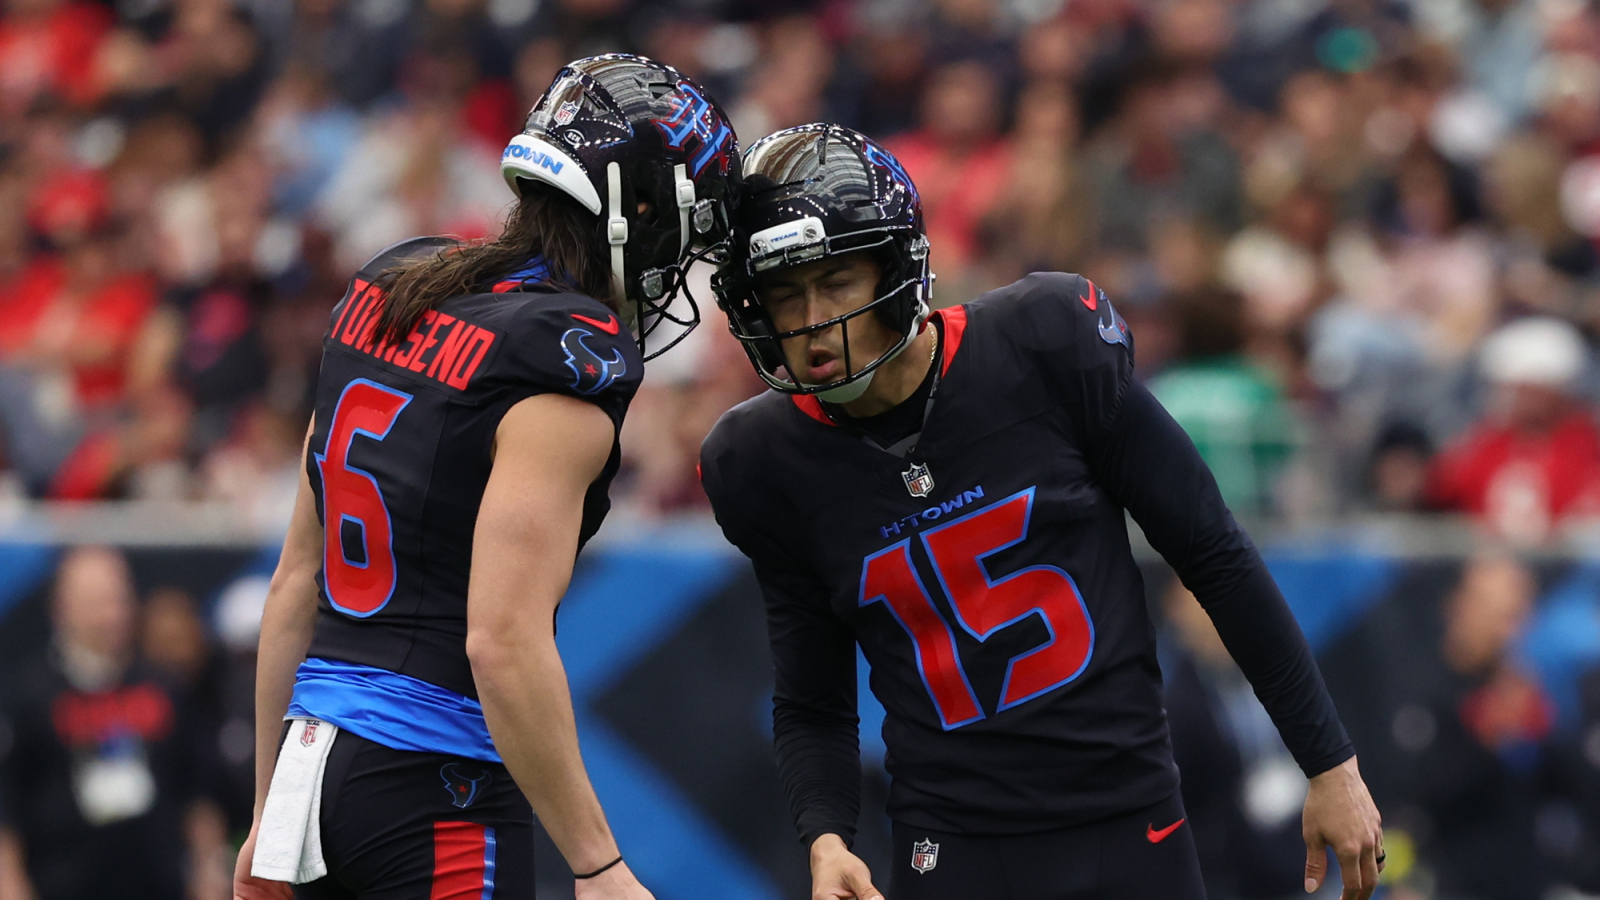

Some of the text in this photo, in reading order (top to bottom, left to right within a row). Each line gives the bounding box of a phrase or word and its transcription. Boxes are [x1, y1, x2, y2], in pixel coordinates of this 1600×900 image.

[556, 109, 572, 122] NFL
[769, 231, 799, 243] TEXANS
[910, 477, 932, 493] NFL
[314, 377, 414, 618] 6
[880, 485, 985, 539] H-TOWN
[858, 485, 1095, 731] 15
[302, 725, 317, 745] NFL
[915, 854, 935, 868] NFL
